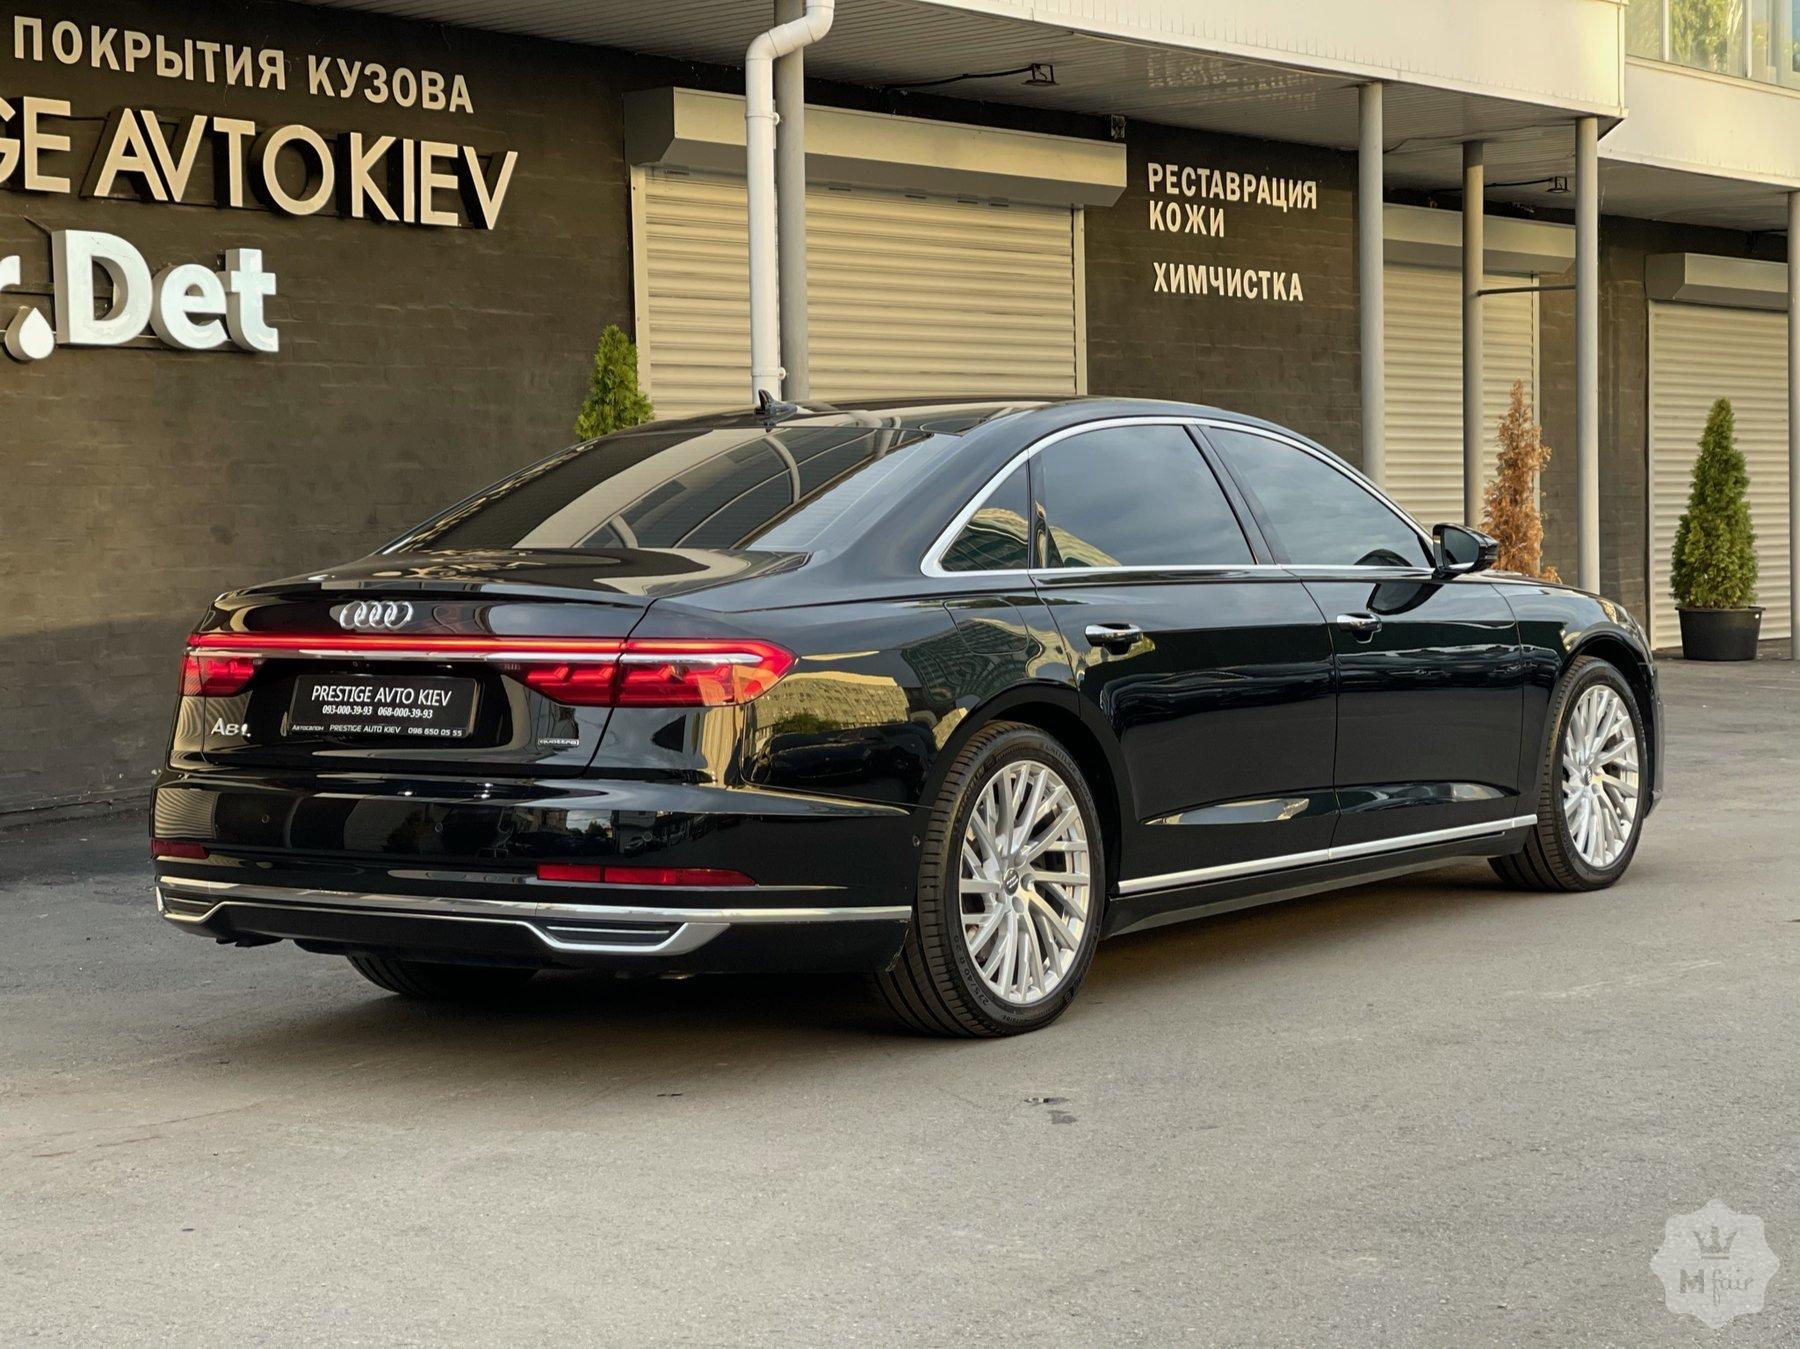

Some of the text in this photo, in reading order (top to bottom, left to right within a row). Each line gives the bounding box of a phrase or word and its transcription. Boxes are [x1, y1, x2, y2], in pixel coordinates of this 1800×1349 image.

[14, 15, 474, 114] ПОКРЫТИЯ КУЗОВА
[1148, 162, 1317, 213] РЕСТАВРАЦИЯ
[1149, 200, 1225, 238] КОЖИ
[1153, 262, 1303, 302] ХИМЧИСТКА
[311, 685, 452, 706] PRESTIGE AVTO KIEV
[322, 704, 433, 719] 093-000-39-93 068-000-39-93
[329, 724, 362, 733] PRESTIGE
[363, 725, 383, 734] AUTO
[384, 726, 402, 734] KIEV
